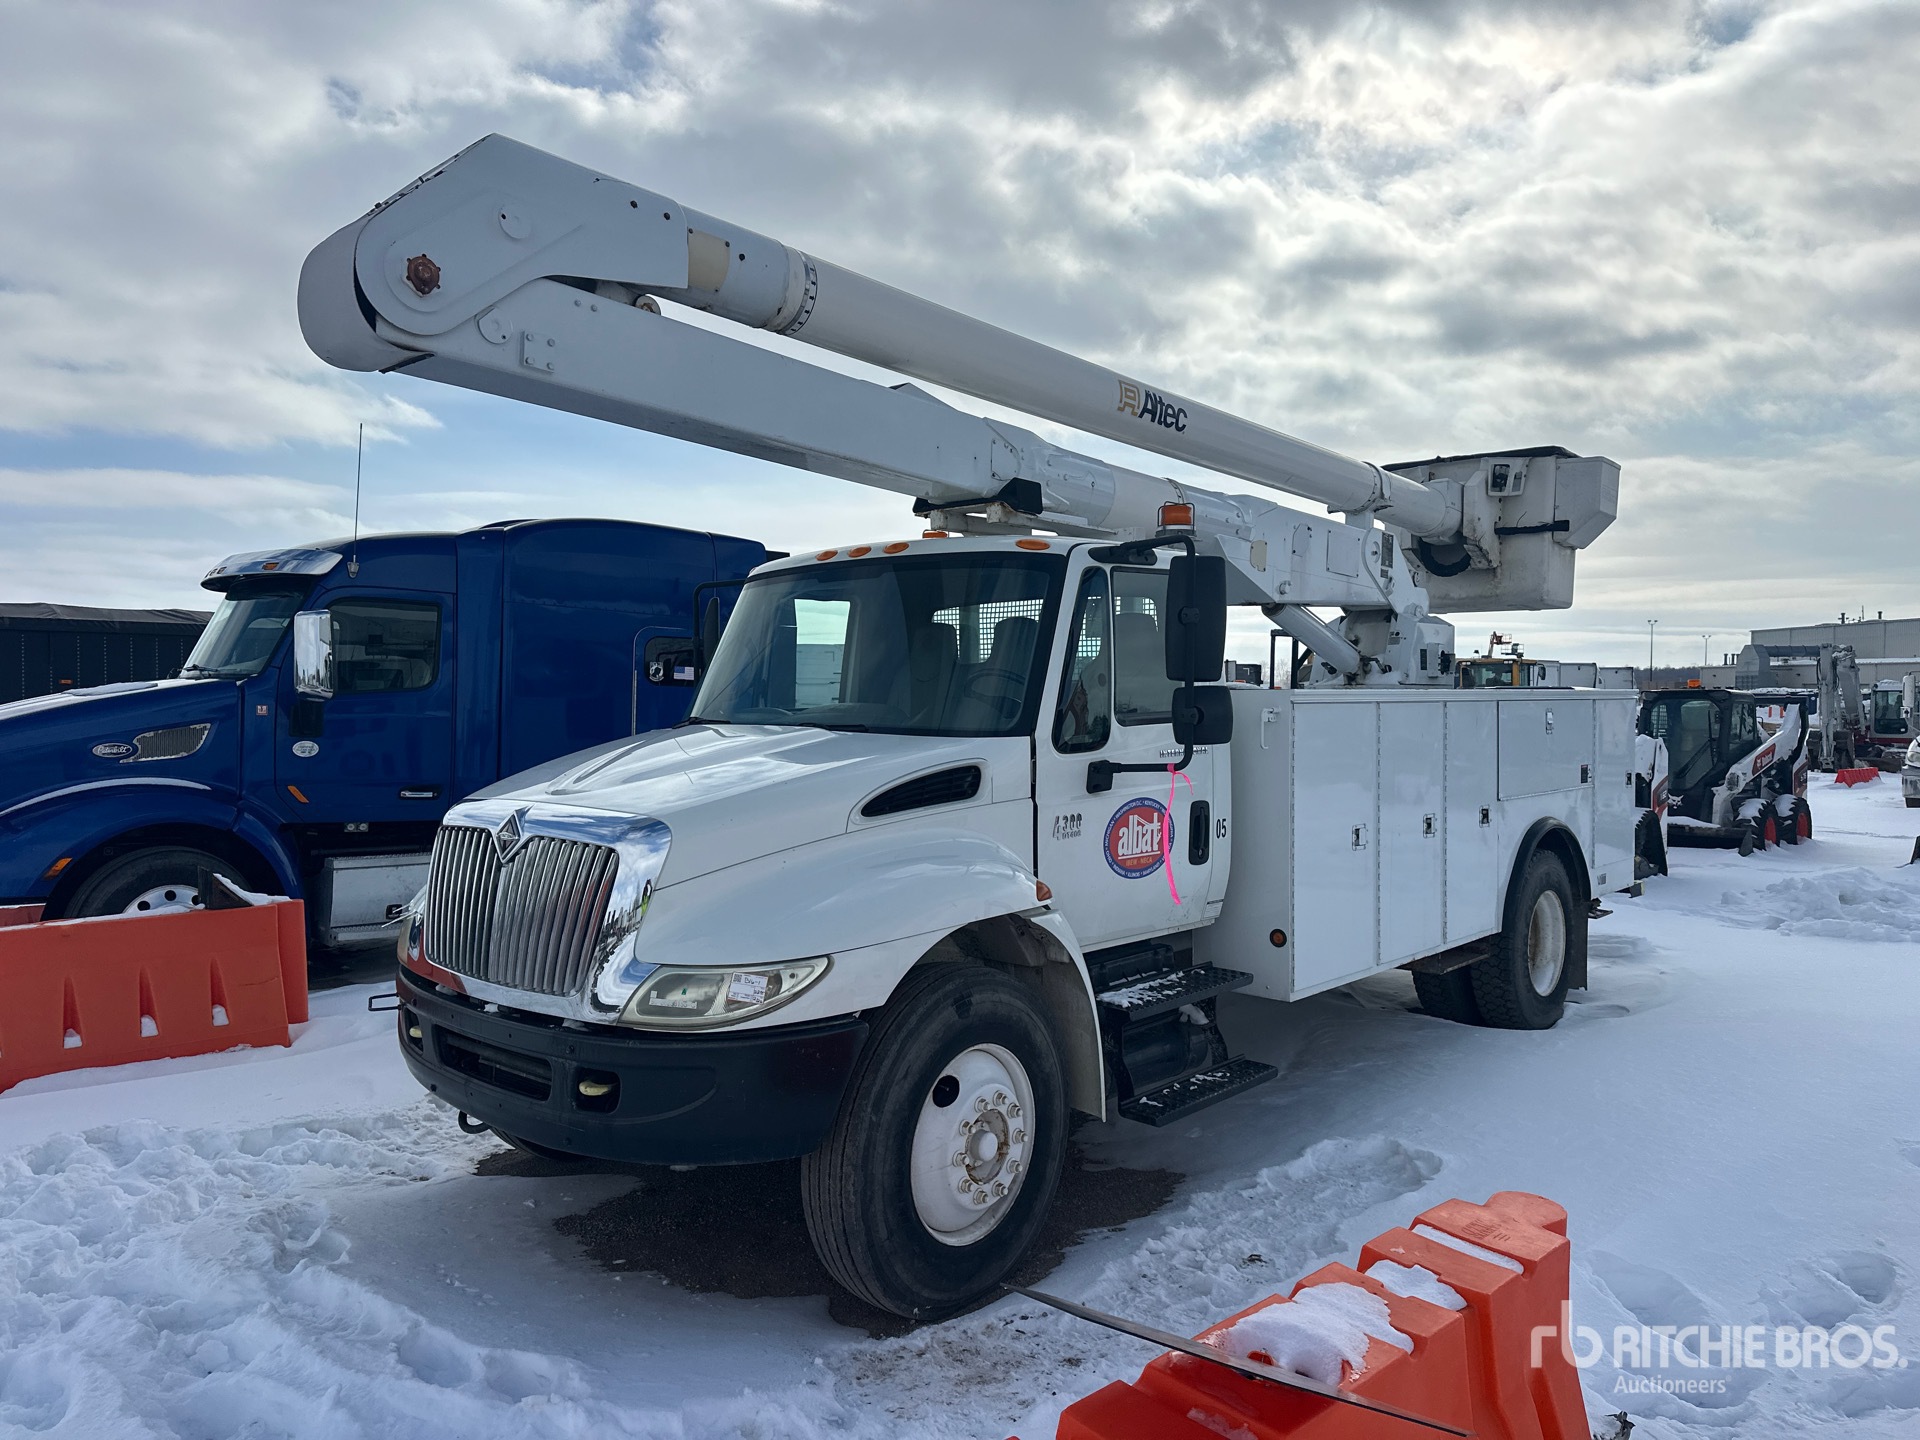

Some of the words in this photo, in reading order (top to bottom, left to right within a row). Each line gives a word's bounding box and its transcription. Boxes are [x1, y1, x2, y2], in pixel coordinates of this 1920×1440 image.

[1138, 389, 1188, 433] Altec
[1160, 746, 1209, 758] INTERNONAL
[1216, 818, 1226, 839] 05
